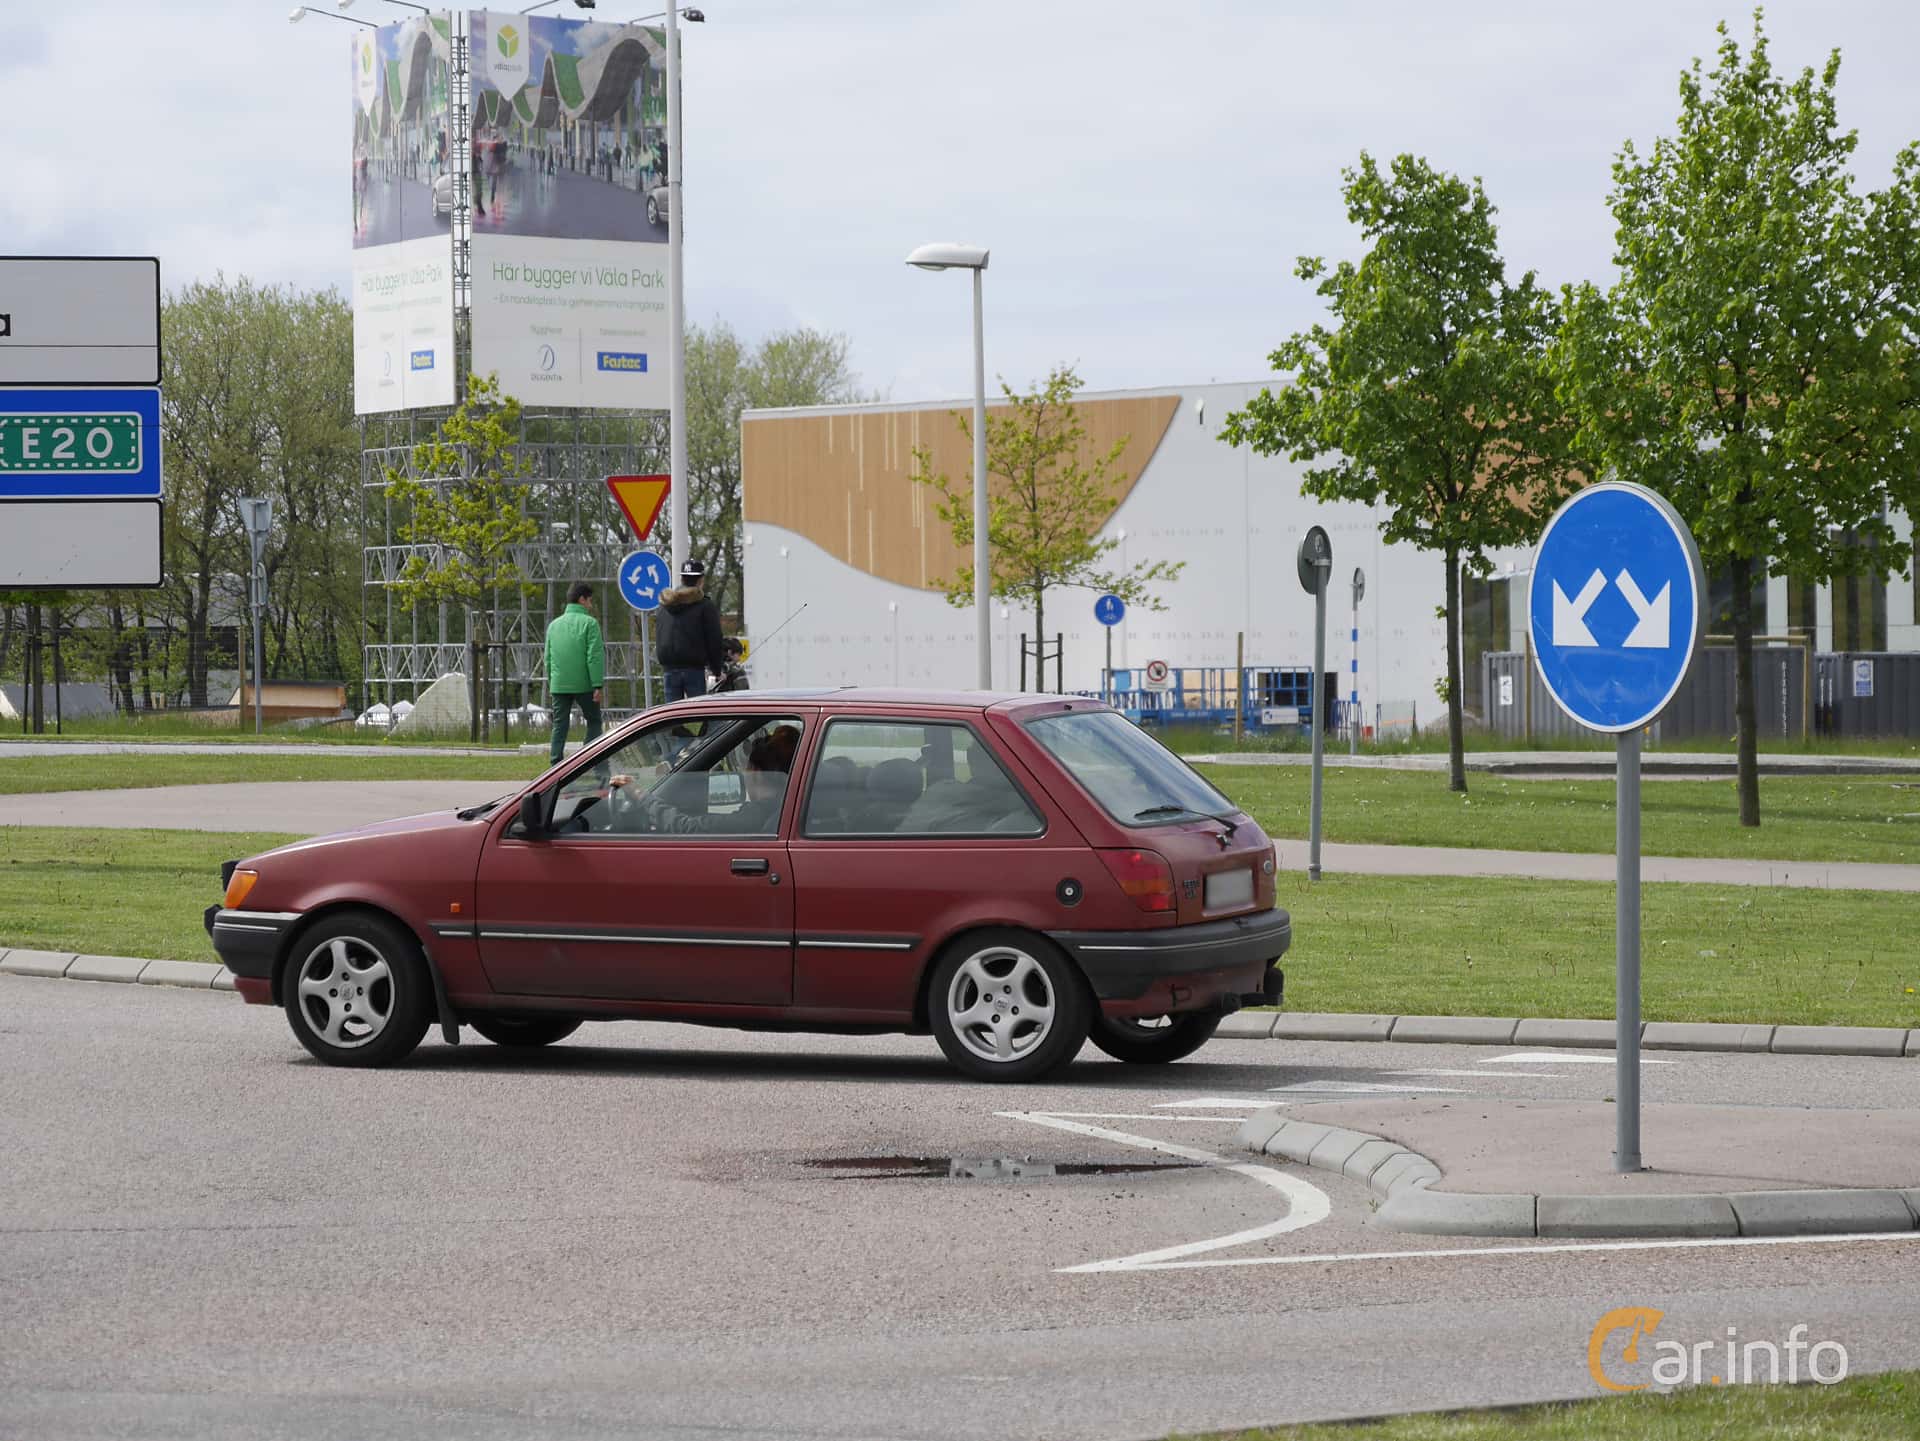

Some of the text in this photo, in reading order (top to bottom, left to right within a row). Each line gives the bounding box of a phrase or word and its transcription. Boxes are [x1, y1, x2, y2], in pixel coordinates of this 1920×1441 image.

[492, 261, 665, 289] Här bygger vi Väla Park
[22, 427, 113, 459] E20
